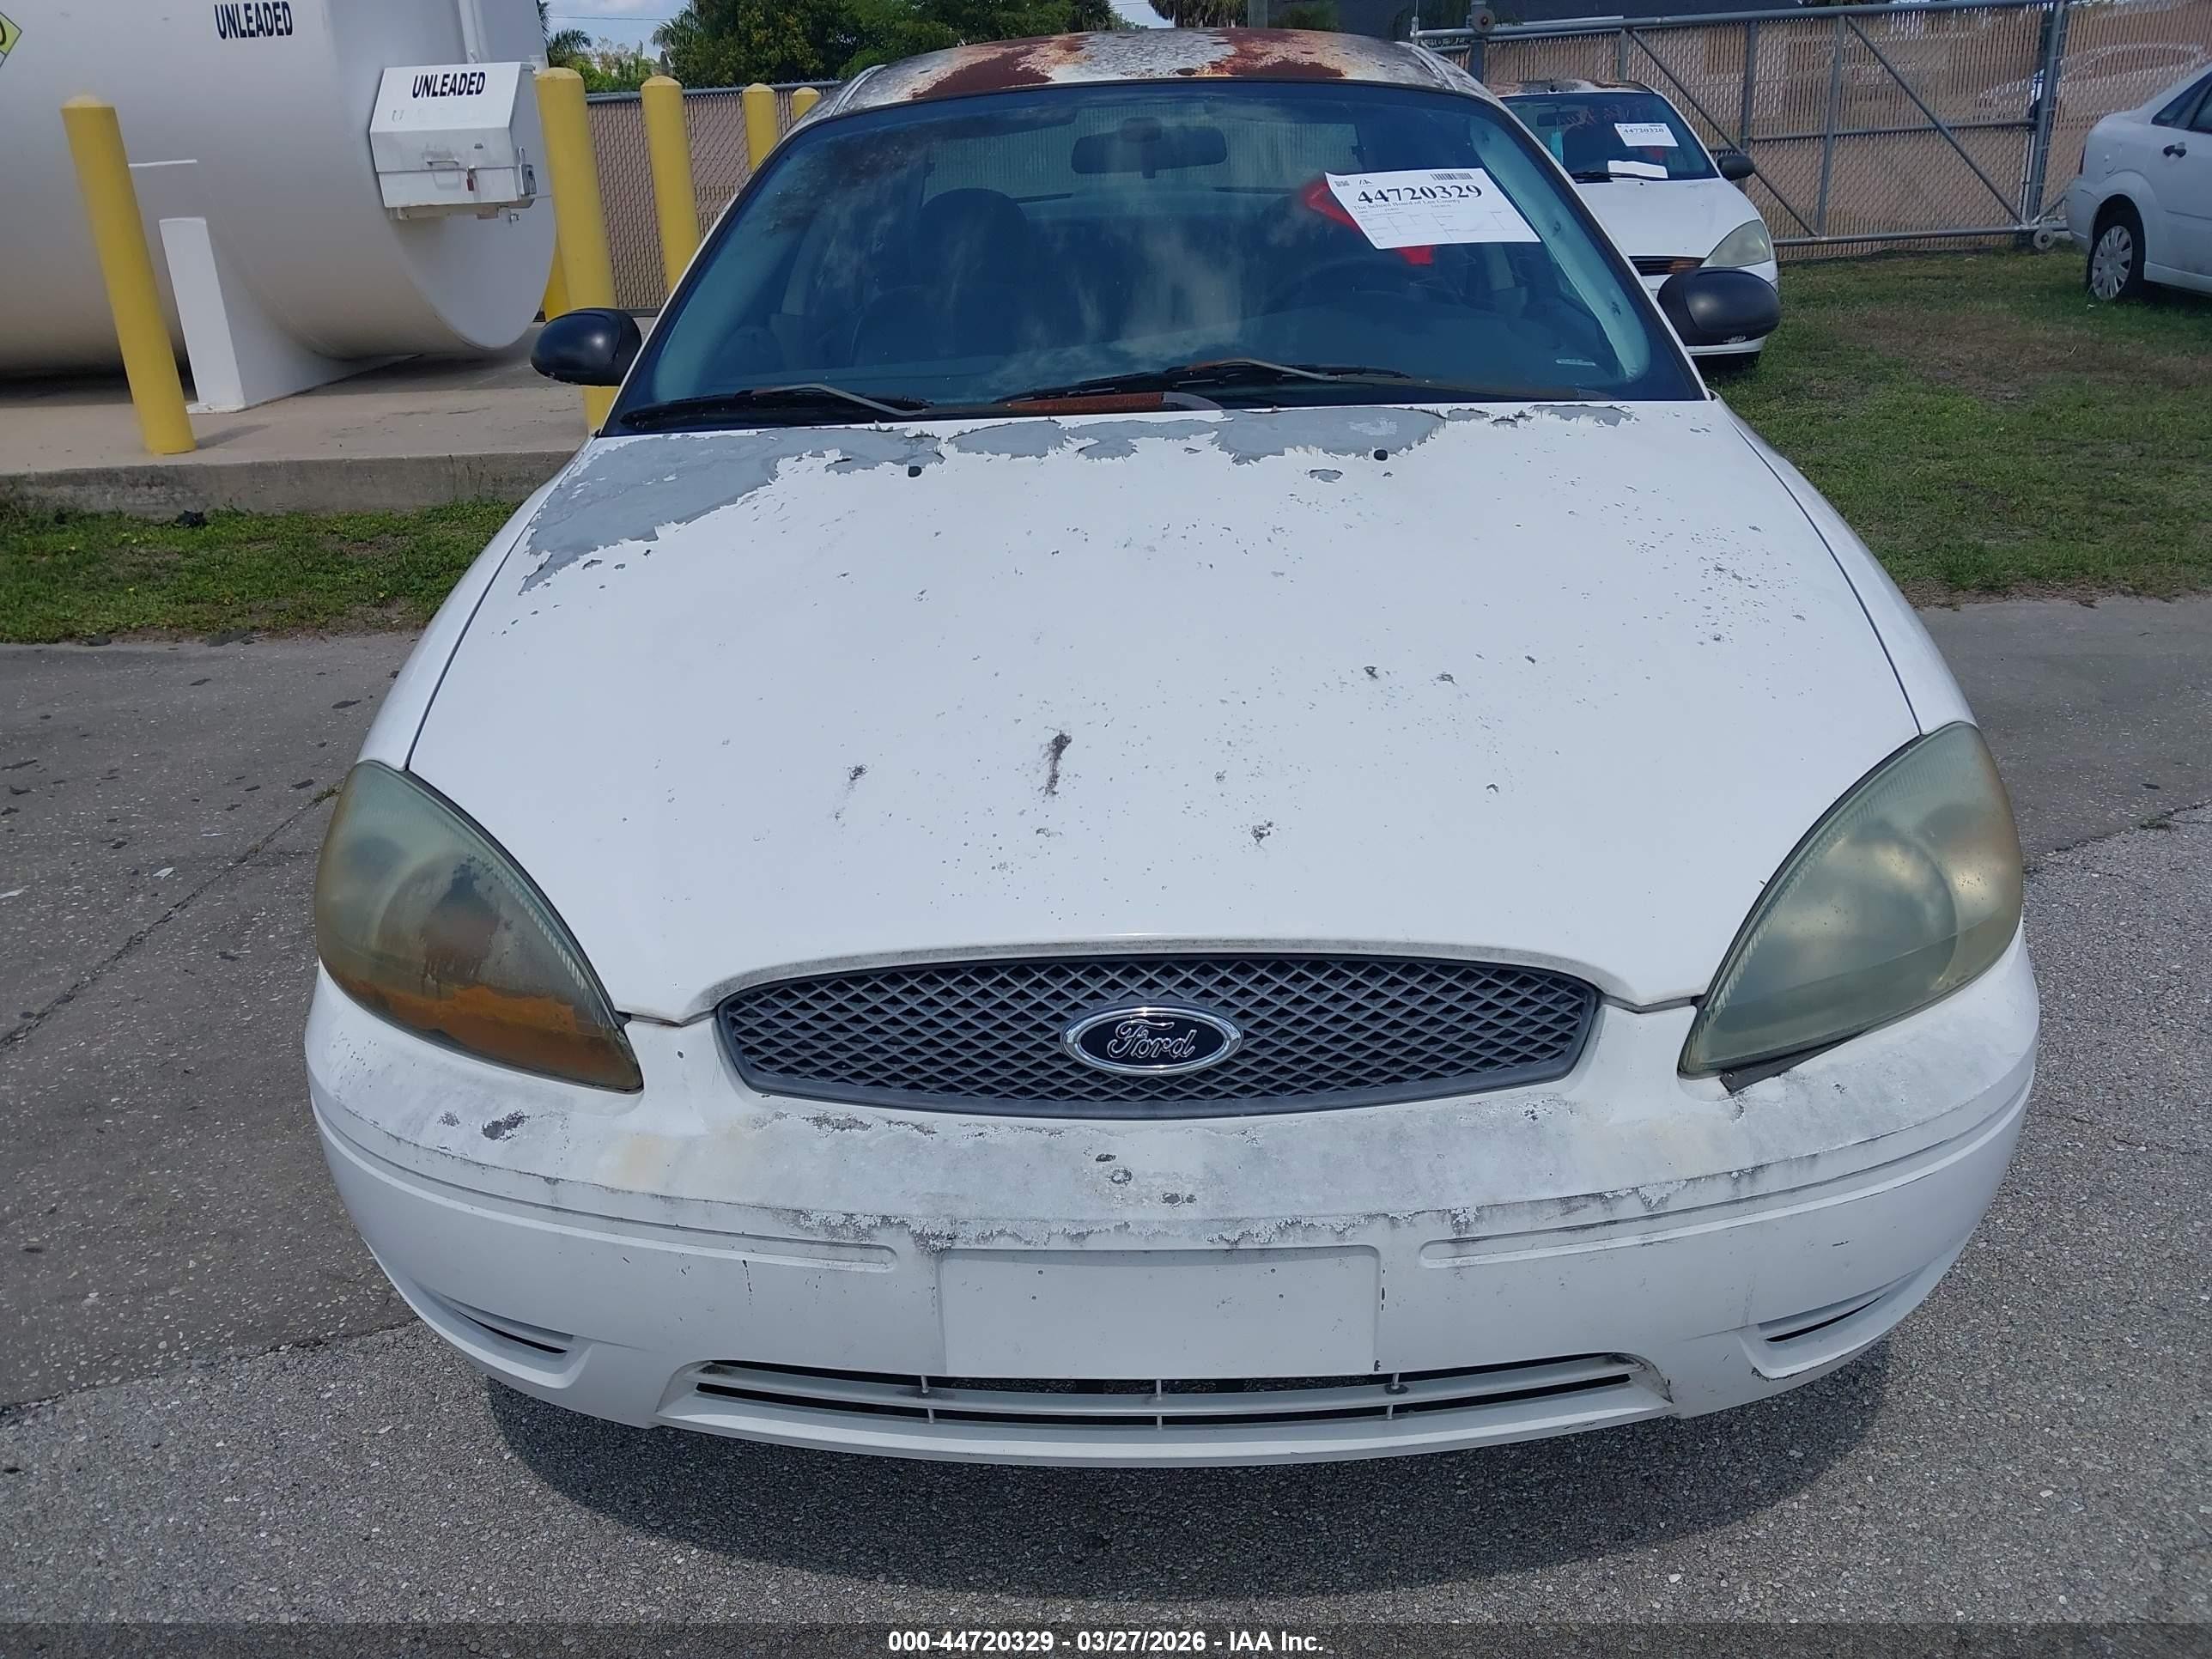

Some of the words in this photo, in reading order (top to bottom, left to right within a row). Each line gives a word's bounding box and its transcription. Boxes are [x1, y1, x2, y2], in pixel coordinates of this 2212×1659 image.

[214, 1, 293, 40] UNLEADED
[411, 71, 486, 99] UNLEADED
[1358, 185, 1482, 204] 44720329
[1106, 1018, 1198, 1060] Ford
